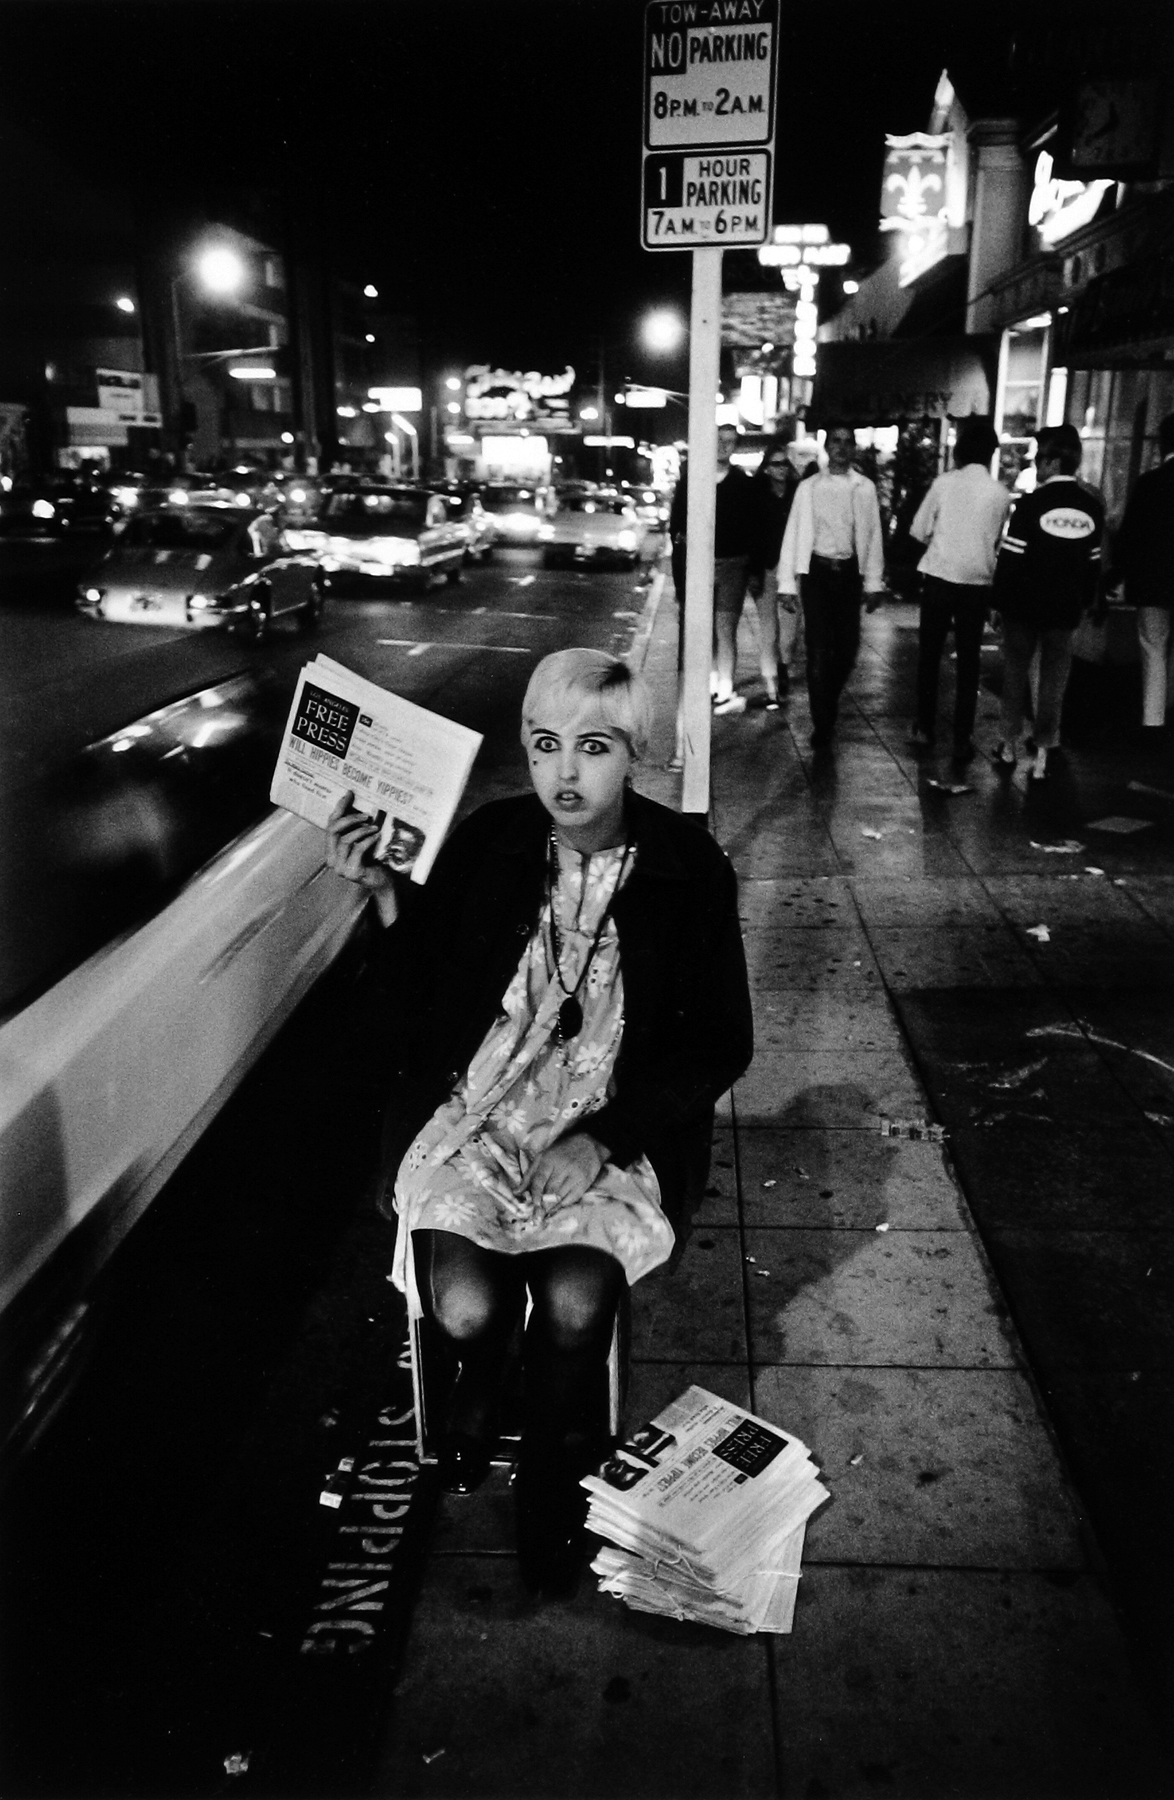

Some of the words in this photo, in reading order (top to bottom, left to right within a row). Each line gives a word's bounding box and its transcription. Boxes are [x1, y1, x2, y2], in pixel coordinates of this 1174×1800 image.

[661, 1, 764, 24] TOW-AWAY
[651, 32, 682, 68] NO
[689, 32, 768, 64] PARKING
[659, 167, 667, 200] 1
[699, 159, 751, 177] HOUR
[686, 178, 762, 207] PARKING
[1046, 517, 1091, 531] HONDA
[306, 700, 349, 731] FREE
[297, 717, 347, 751] PRESS
[289, 735, 306, 755] WILL
[310, 746, 340, 770] HIPPIES
[342, 763, 374, 788] BECOME
[720, 1424, 759, 1461] PRESS
[301, 1405, 419, 1653] STOPPING
